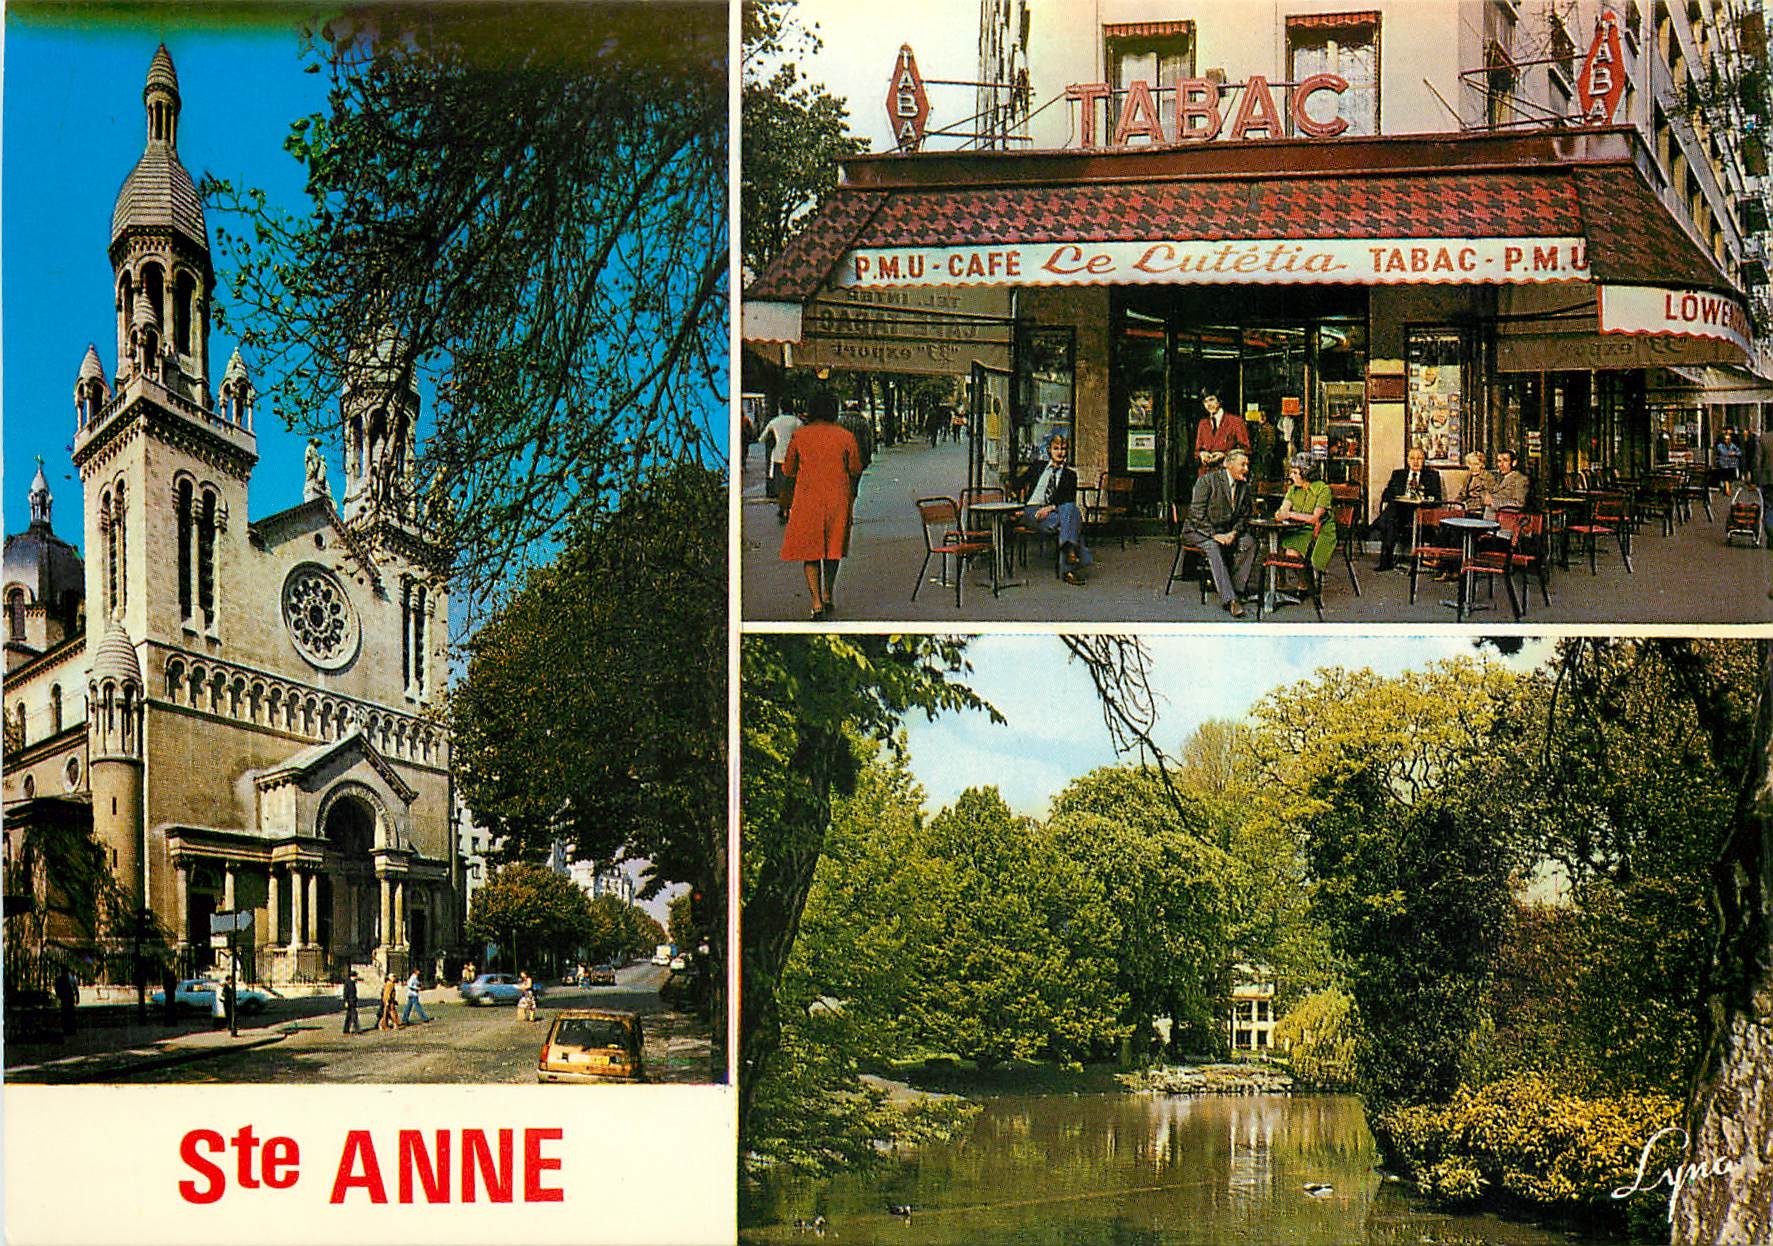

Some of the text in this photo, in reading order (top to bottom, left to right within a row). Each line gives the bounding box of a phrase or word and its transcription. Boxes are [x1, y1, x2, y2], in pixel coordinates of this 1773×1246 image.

[1066, 73, 1349, 148] TABAC
[856, 254, 925, 281] P.M.U
[1042, 244, 1117, 275] Le
[1132, 243, 1347, 274] Lutétia
[1369, 246, 1477, 273] TABAC
[1504, 246, 1590, 272] P.M.U
